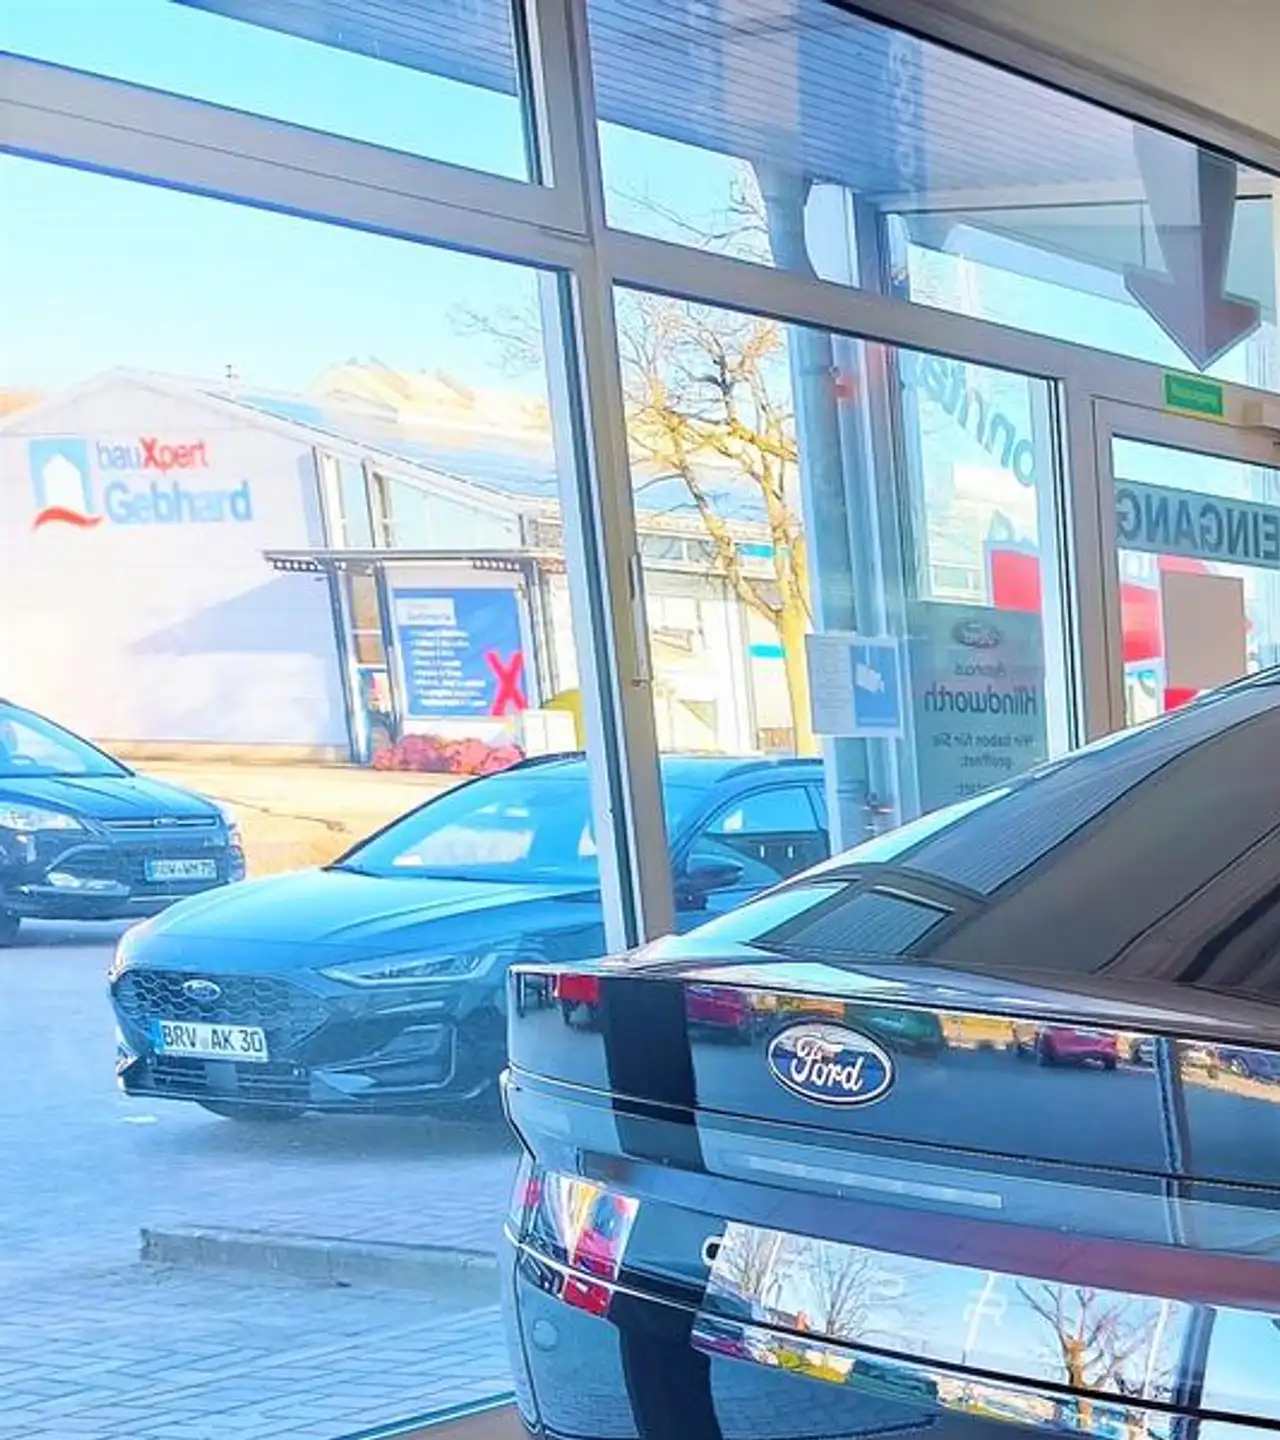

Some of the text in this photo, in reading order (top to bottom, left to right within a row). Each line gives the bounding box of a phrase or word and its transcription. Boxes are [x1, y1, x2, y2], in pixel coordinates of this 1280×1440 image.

[96, 438, 209, 474] bauXpert
[106, 480, 253, 522] Gebhard
[163, 1024, 264, 1053] BRV AK 30
[790, 1034, 865, 1092] Ford
